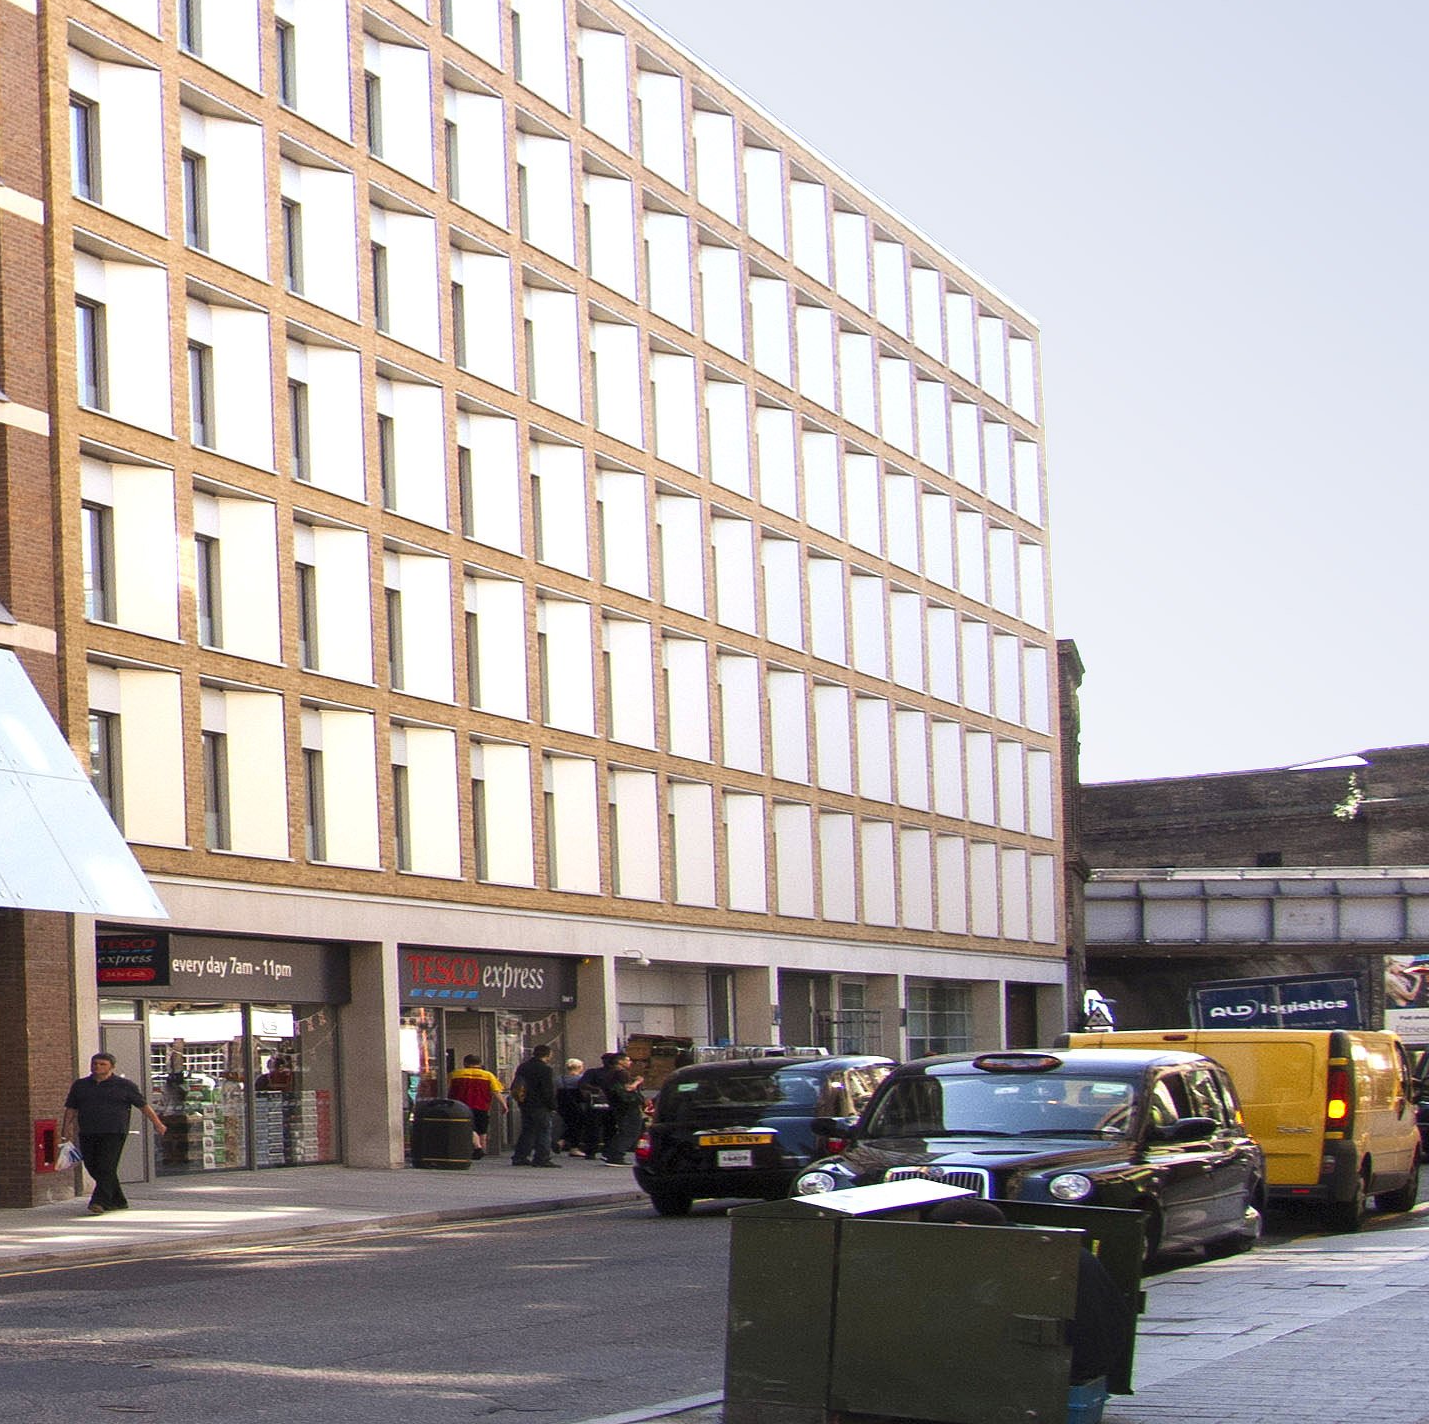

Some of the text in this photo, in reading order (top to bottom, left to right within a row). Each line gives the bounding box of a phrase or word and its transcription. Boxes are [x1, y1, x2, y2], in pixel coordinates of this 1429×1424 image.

[99, 938, 157, 950] TESCO
[97, 953, 153, 967] express
[172, 957, 205, 977] every
[206, 956, 227, 978] day
[229, 956, 253, 975] 7am
[262, 959, 292, 980] 11pm
[407, 954, 545, 998] TESCO express
[1260, 999, 1348, 1015] logistics
